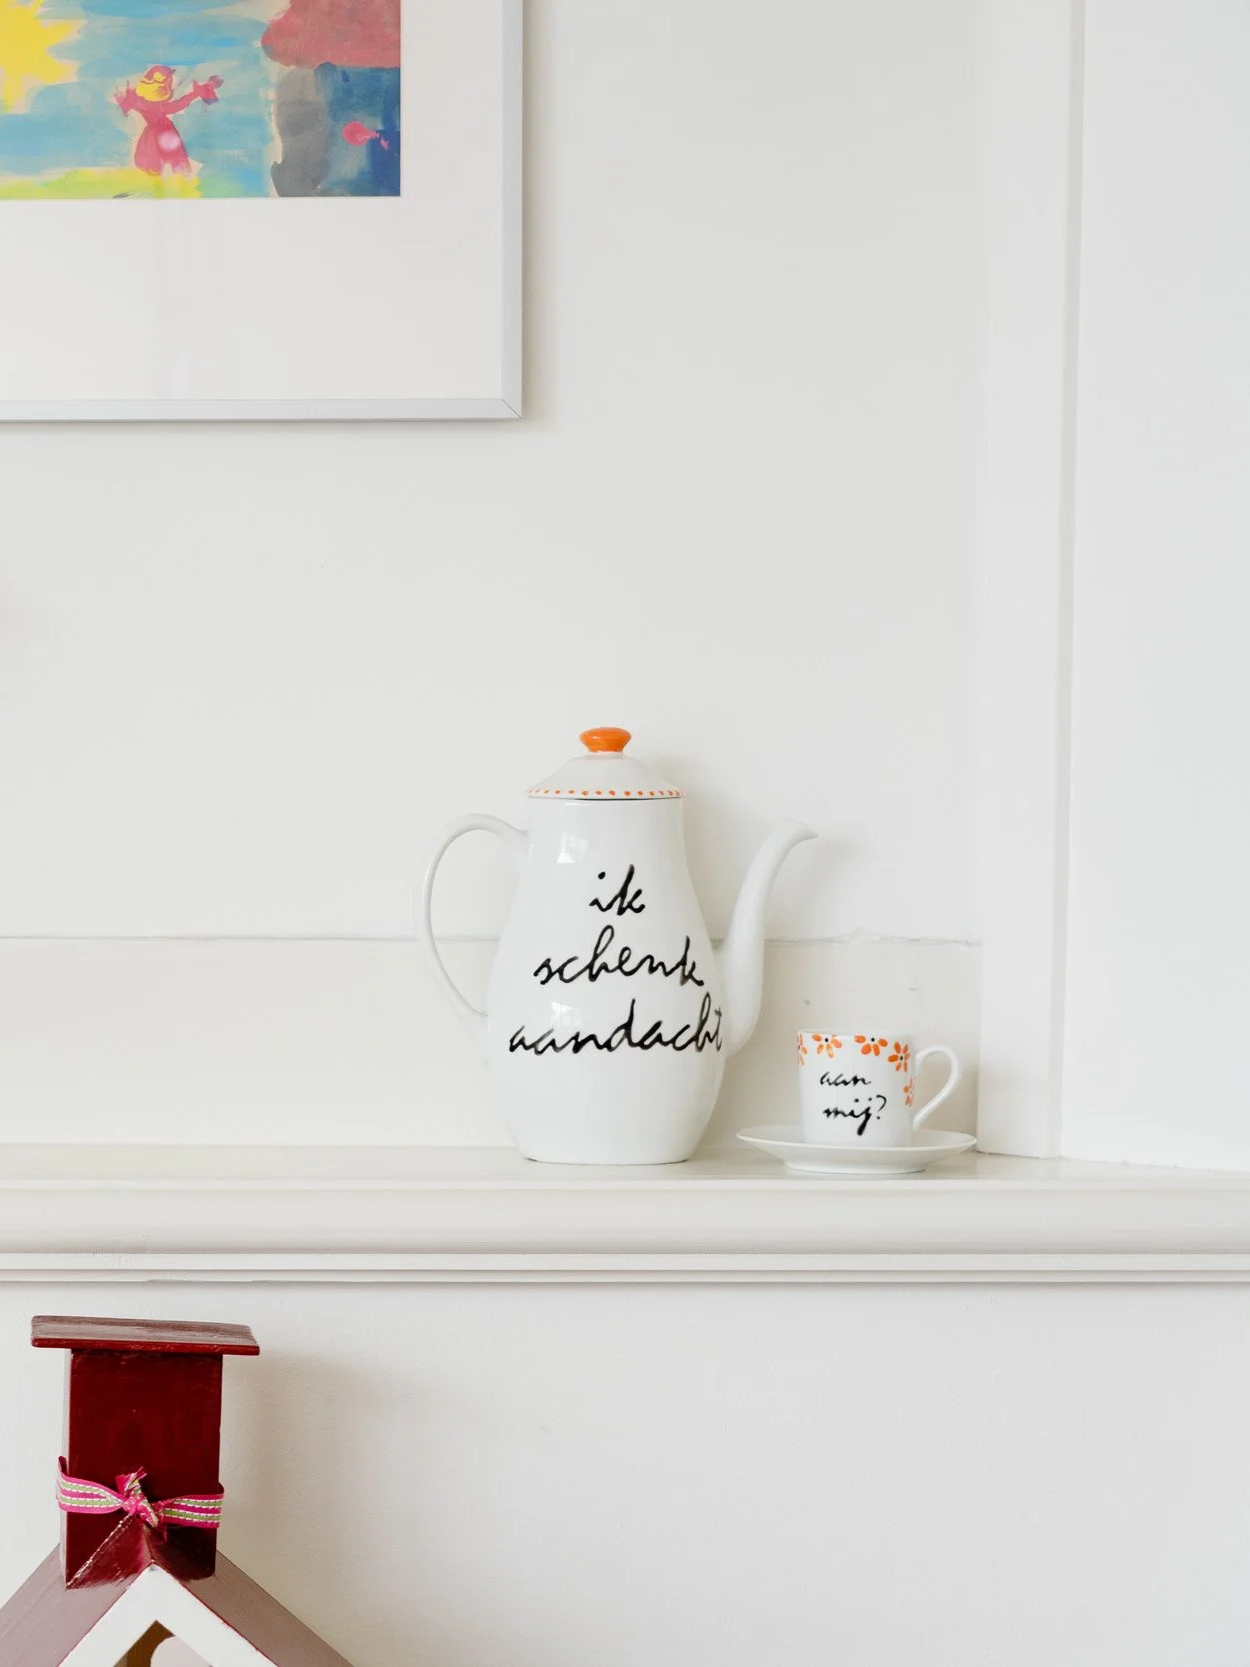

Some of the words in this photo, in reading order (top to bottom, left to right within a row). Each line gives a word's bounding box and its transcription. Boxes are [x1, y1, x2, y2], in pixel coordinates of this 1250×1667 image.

[588, 864, 646, 916] ik
[532, 924, 705, 987] schenk
[508, 991, 724, 1056] aandacht
[819, 1071, 872, 1086] aan
[822, 1094, 887, 1137] mij?
